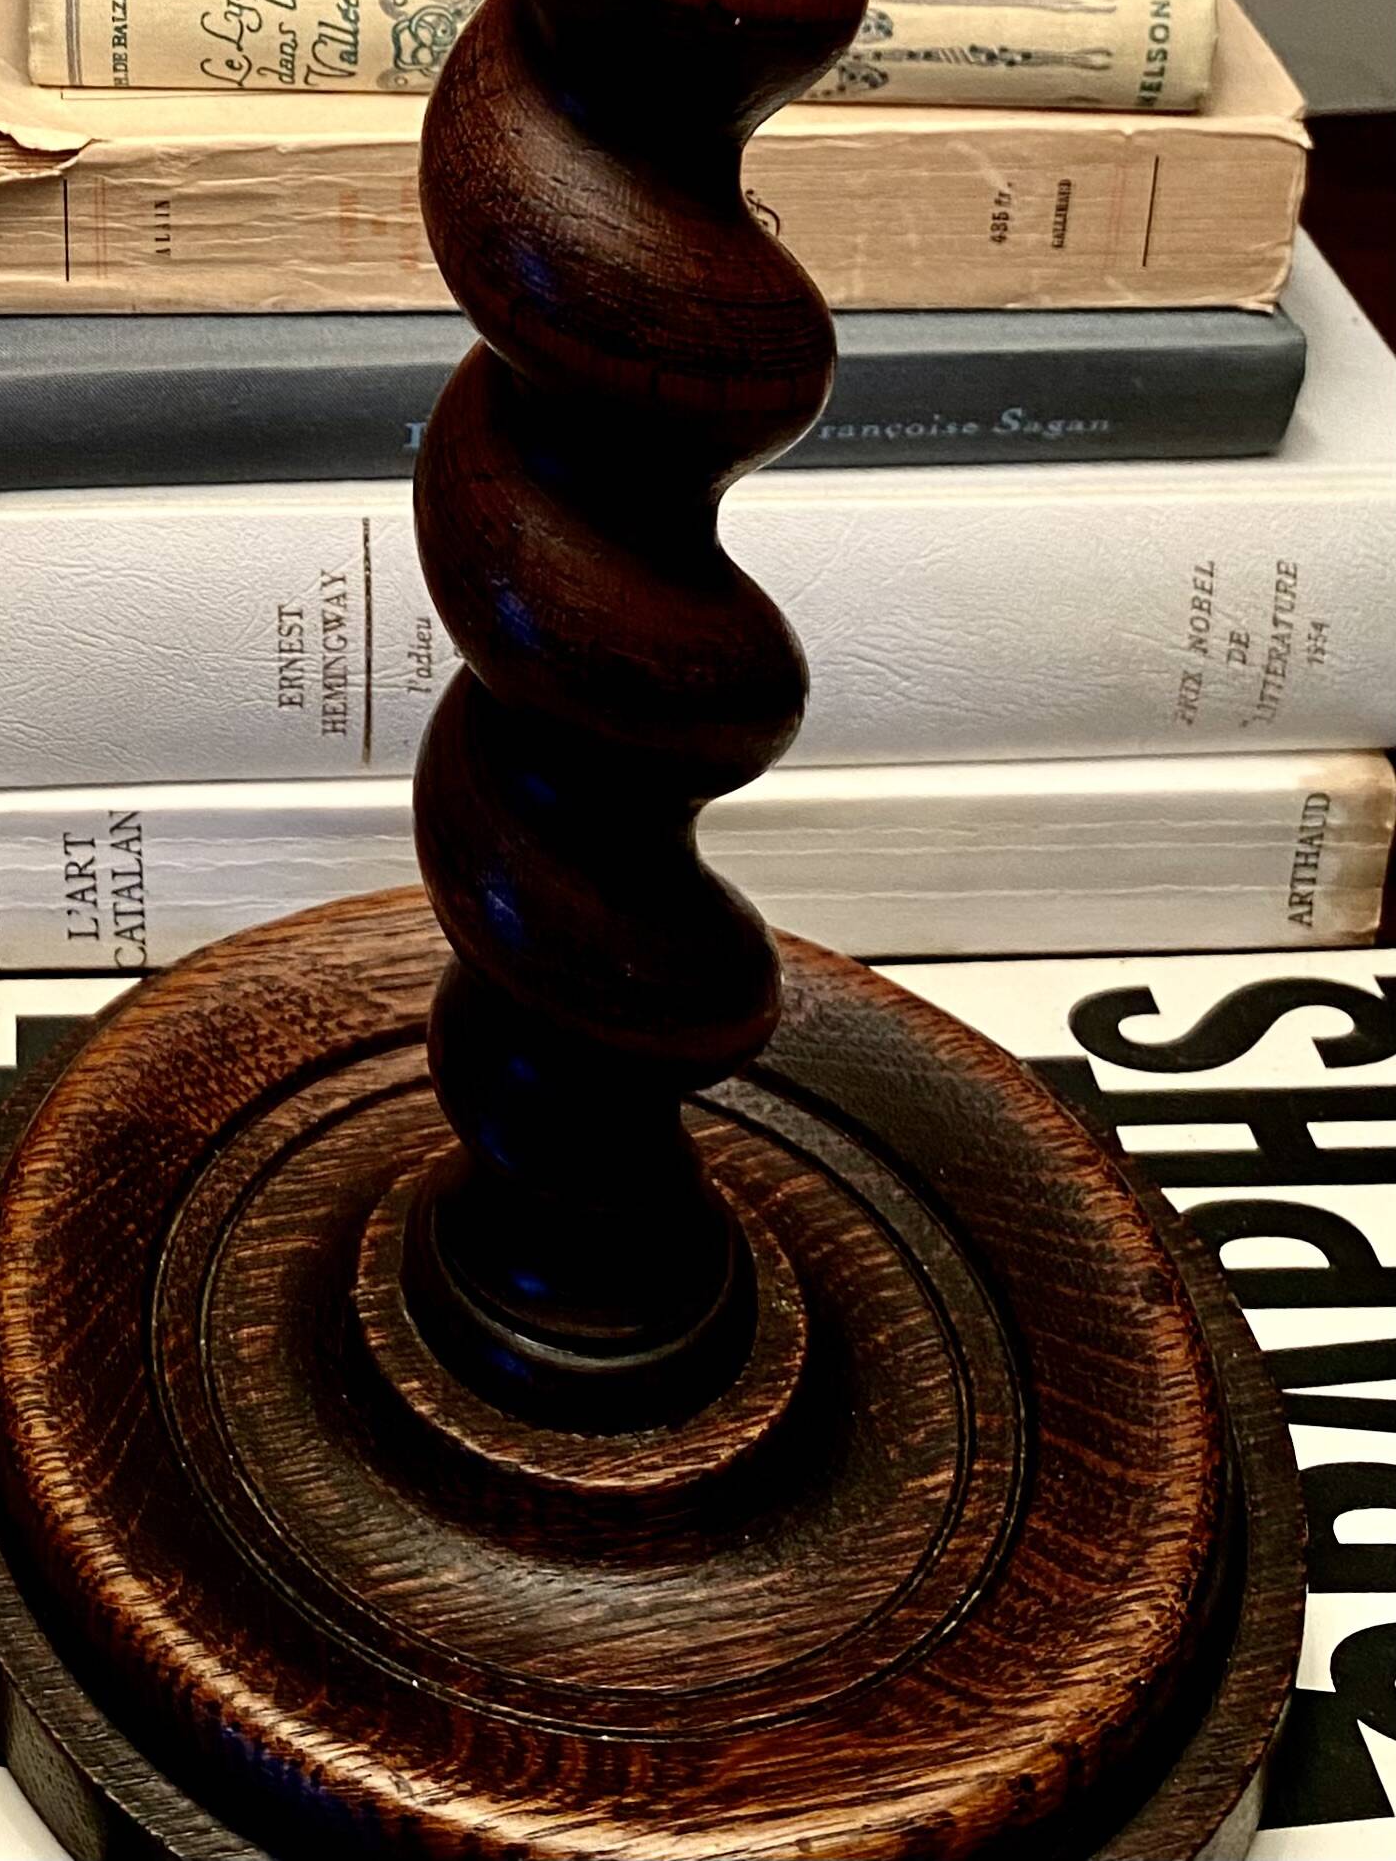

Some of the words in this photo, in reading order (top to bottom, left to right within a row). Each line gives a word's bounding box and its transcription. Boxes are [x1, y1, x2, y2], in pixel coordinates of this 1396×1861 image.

[200, 55, 252, 87] Le
[256, 21, 299, 85] dans
[154, 198, 172, 257] ALAIN
[1051, 178, 1073, 249] GALLIMARD
[818, 414, 979, 440] rançoise
[993, 406, 1109, 439] Sagan
[1187, 560, 1215, 655] NOBEL
[278, 603, 304, 709] ERNEST
[322, 569, 348, 736] HEMINGWAY
[1226, 630, 1250, 665] DE
[1306, 620, 1331, 665] 1954
[1174, 670, 1202, 726] PRIX
[63, 832, 100, 941] L'ART
[108, 810, 148, 969] CATALAN
[1287, 790, 1331, 928] ARTHAUD
